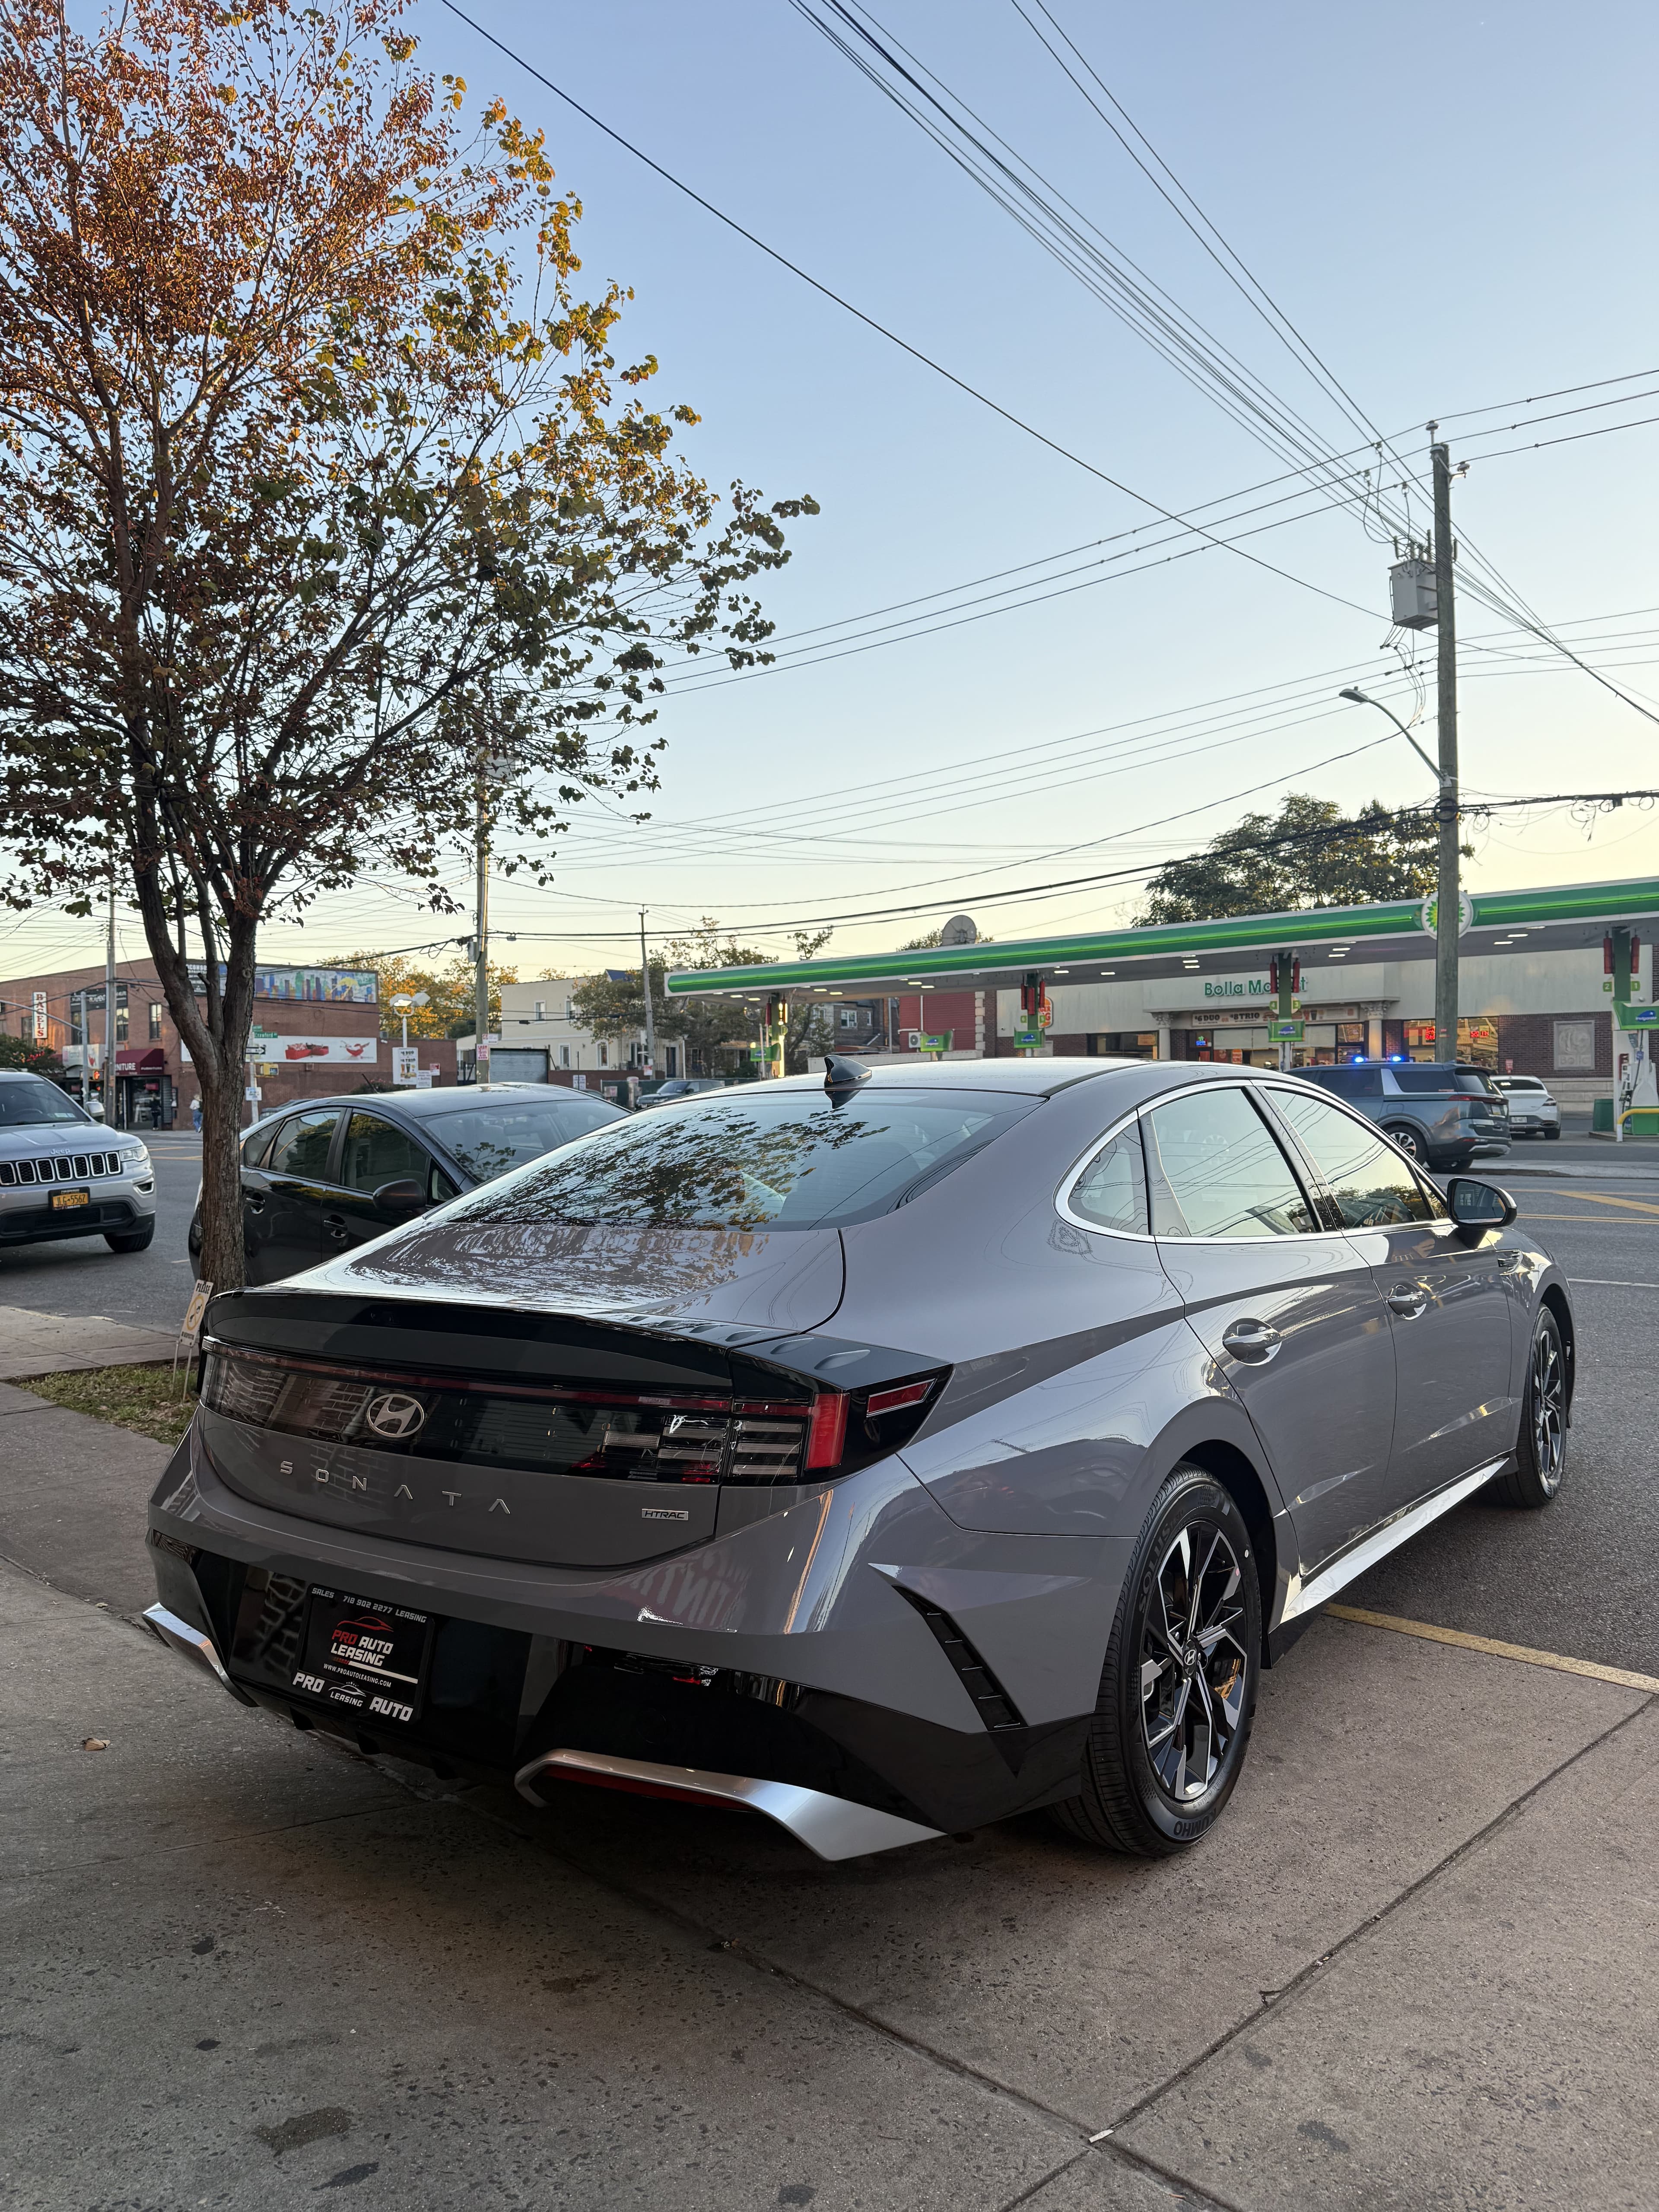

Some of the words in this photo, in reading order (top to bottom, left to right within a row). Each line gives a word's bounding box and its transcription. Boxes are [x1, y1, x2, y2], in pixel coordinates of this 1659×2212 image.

[1205, 982, 1243, 996] Bolla
[1249, 976, 1306, 994] Mat
[36, 994, 44, 1036] BAGELS
[115, 1062, 136, 1071] NITURE
[196, 1282, 211, 1294] PLEASE
[280, 1460, 511, 1514] SONATA
[644, 1511, 685, 1519] HTRAC
[1138, 1522, 1171, 1614] SOLUS
[311, 1587, 335, 1599] SALES
[343, 1595, 355, 1604] 718
[356, 1599, 372, 1608] 902
[372, 1603, 393, 1614] 2277
[395, 1609, 427, 1623] LEASING
[331, 1629, 358, 1645] PRO
[358, 1636, 394, 1655] AUTO
[331, 1643, 385, 1666] LEASING
[324, 1663, 392, 1688] WWW.PROAUTOLEASING.COM
[292, 1672, 325, 1693] PRO
[330, 1691, 363, 1707] LEASING
[369, 1696, 414, 1721] AUTO
[1173, 1808, 1217, 1838] KUMHO
